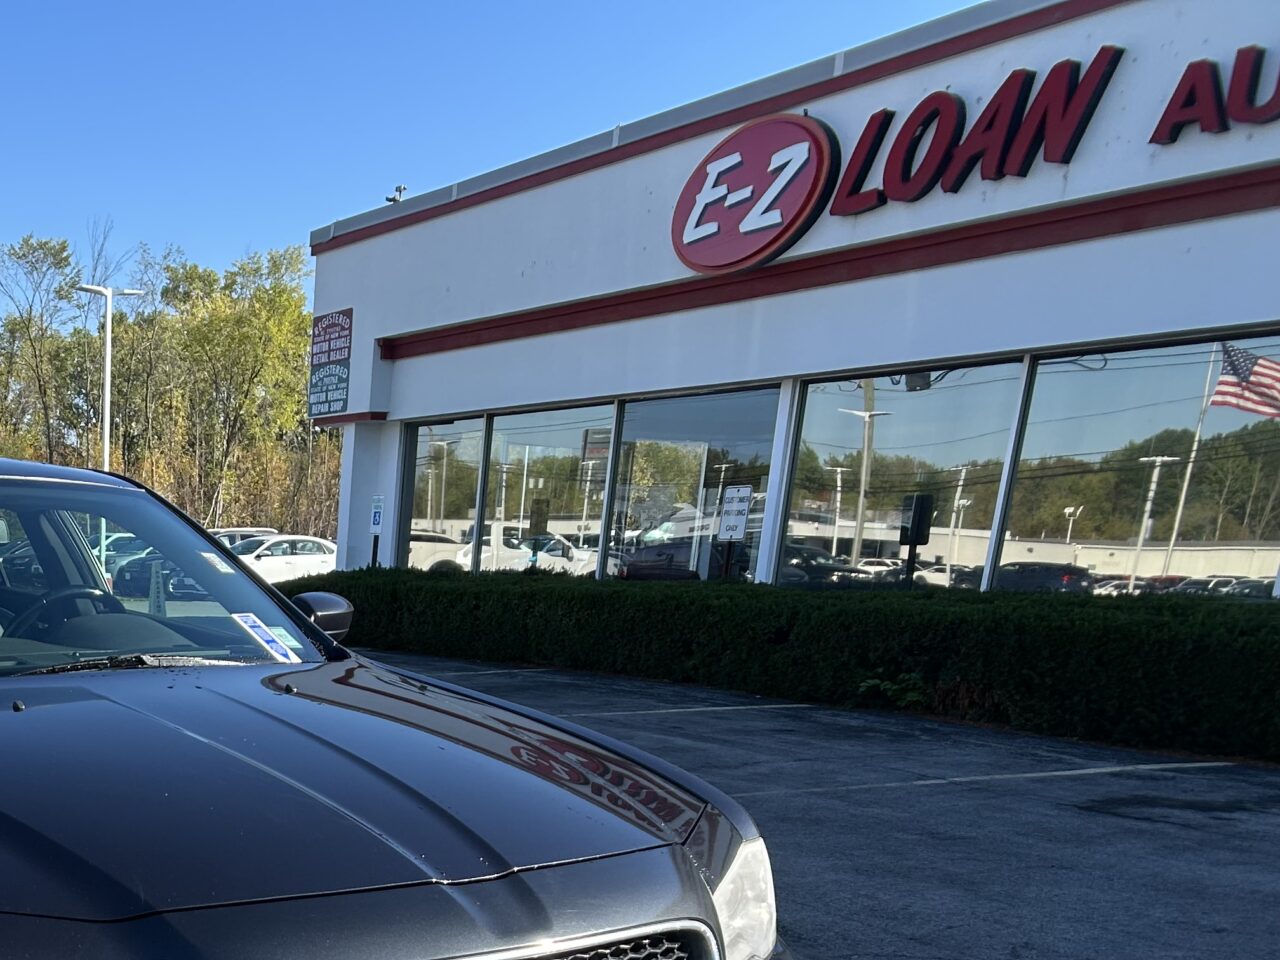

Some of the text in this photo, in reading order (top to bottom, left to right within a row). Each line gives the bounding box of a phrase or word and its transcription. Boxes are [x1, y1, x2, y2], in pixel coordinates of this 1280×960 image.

[682, 45, 1280, 246] E-Z LOAN AU
[314, 313, 350, 336] REGISTERED
[313, 335, 350, 354] MOTOR VEHICLE
[313, 348, 349, 364] RETAIL DEALER
[312, 365, 348, 384] REGISTERED
[310, 388, 347, 403] MOTOR VEHICLE
[312, 400, 343, 414] REPAIR SHOP
